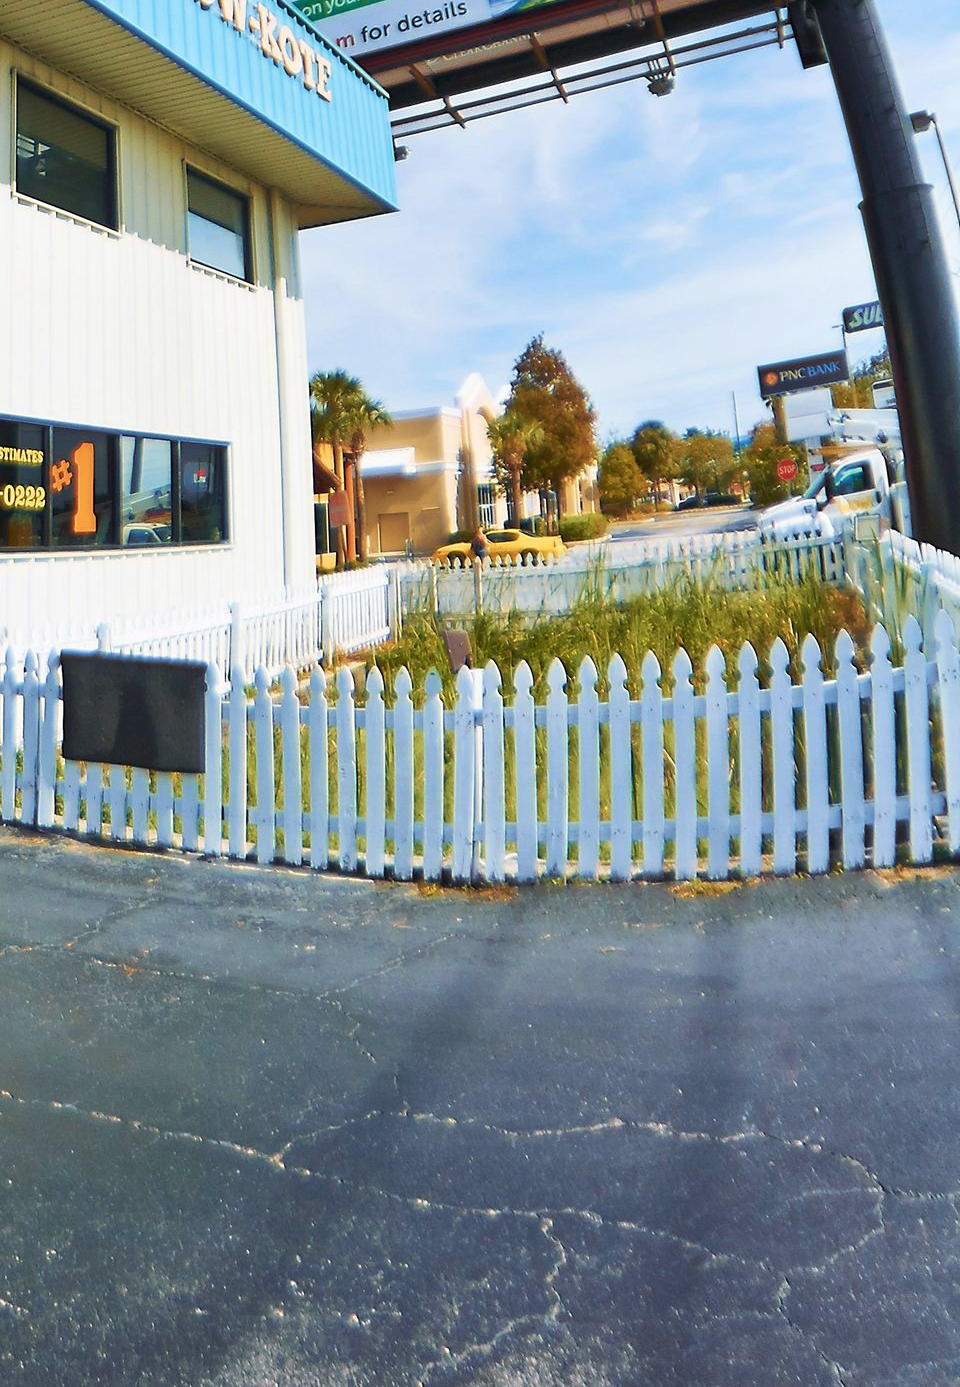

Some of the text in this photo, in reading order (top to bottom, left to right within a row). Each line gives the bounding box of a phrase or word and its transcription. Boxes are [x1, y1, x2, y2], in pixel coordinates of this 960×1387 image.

[302, 2, 323, 18] on
[361, 24, 390, 43] for
[398, 1, 468, 32] details
[779, 361, 841, 382] PNC BANK
[778, 463, 796, 475] STOP
